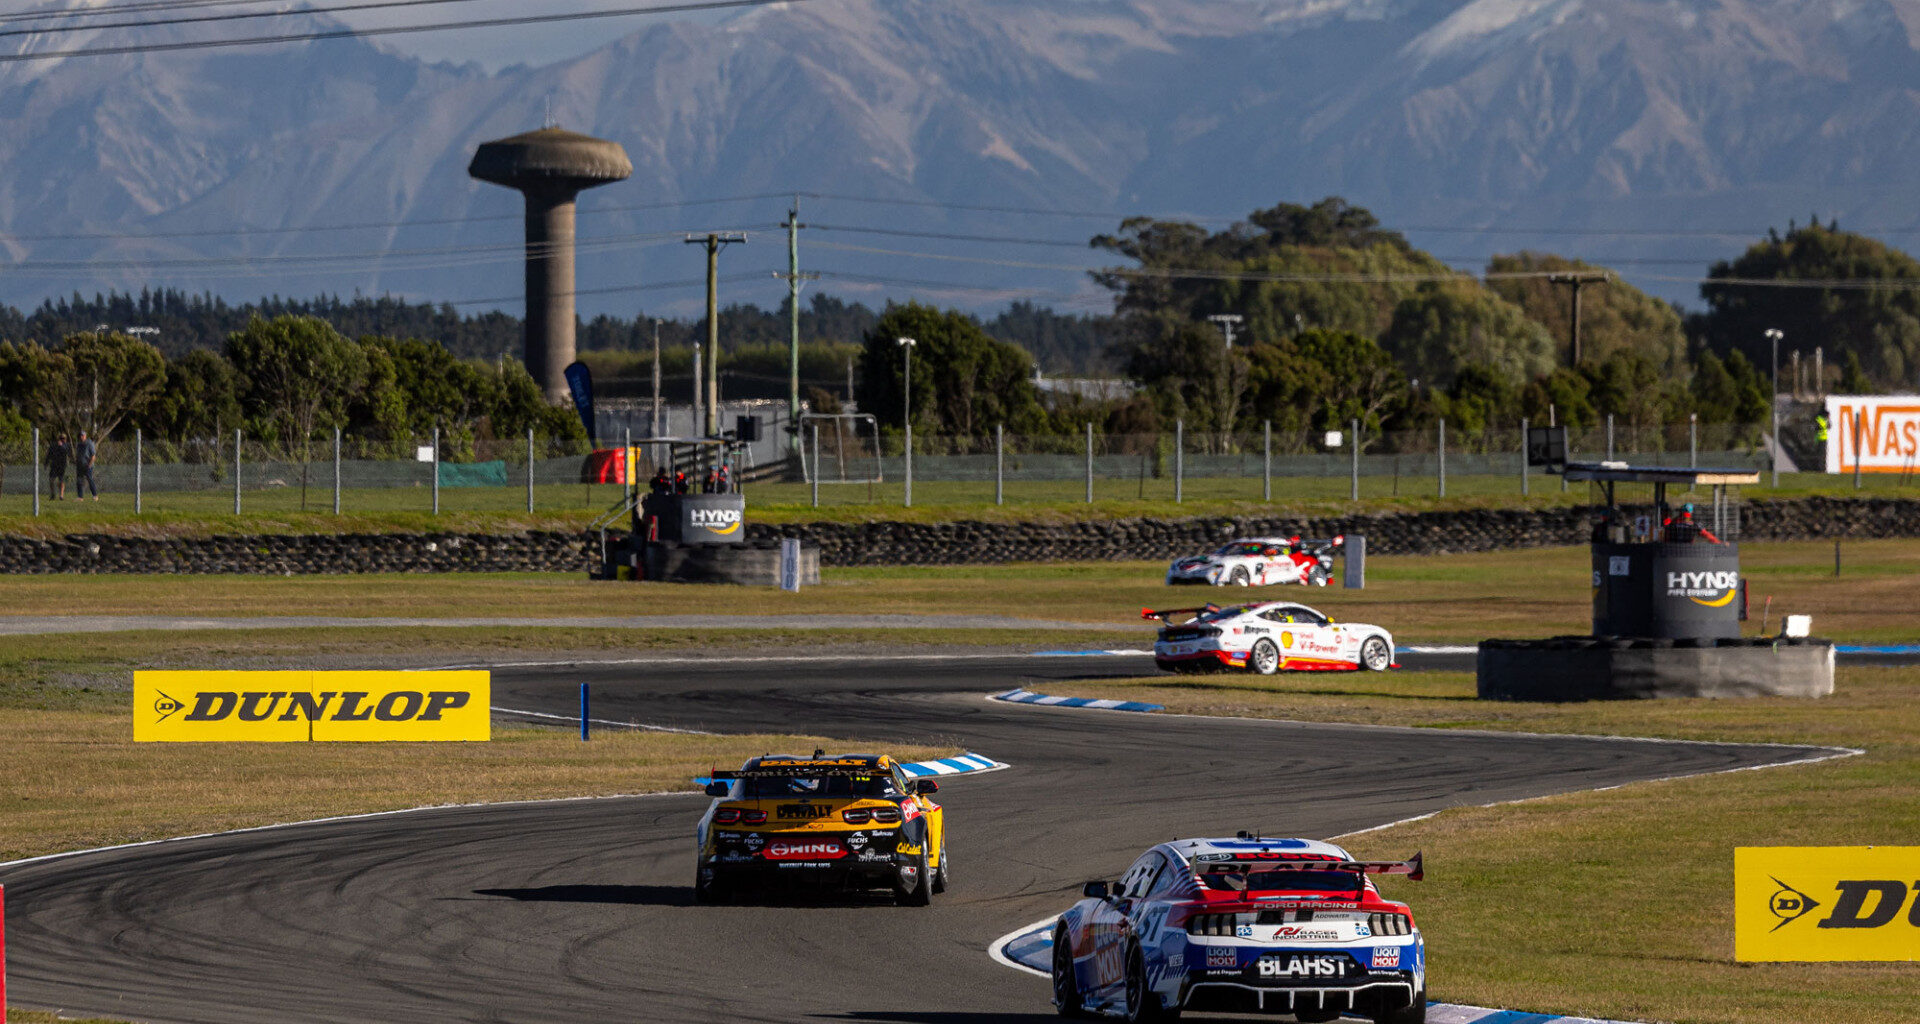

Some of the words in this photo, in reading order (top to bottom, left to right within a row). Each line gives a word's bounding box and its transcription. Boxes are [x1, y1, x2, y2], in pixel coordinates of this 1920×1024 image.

[1839, 405, 1920, 456] WAS
[691, 509, 741, 523] HYNDS
[1667, 571, 1738, 589] HYNDS
[184, 691, 471, 721] DUNLOP
[776, 804, 833, 819] DEWALT
[790, 844, 840, 853] HINO
[1300, 901, 1358, 909] RACING
[1208, 948, 1236, 957] LIQUI
[1374, 948, 1400, 956] LIQUI
[1208, 957, 1236, 966] MOLY
[1259, 956, 1350, 976] BLAHST
[1373, 957, 1399, 966] MOLY
